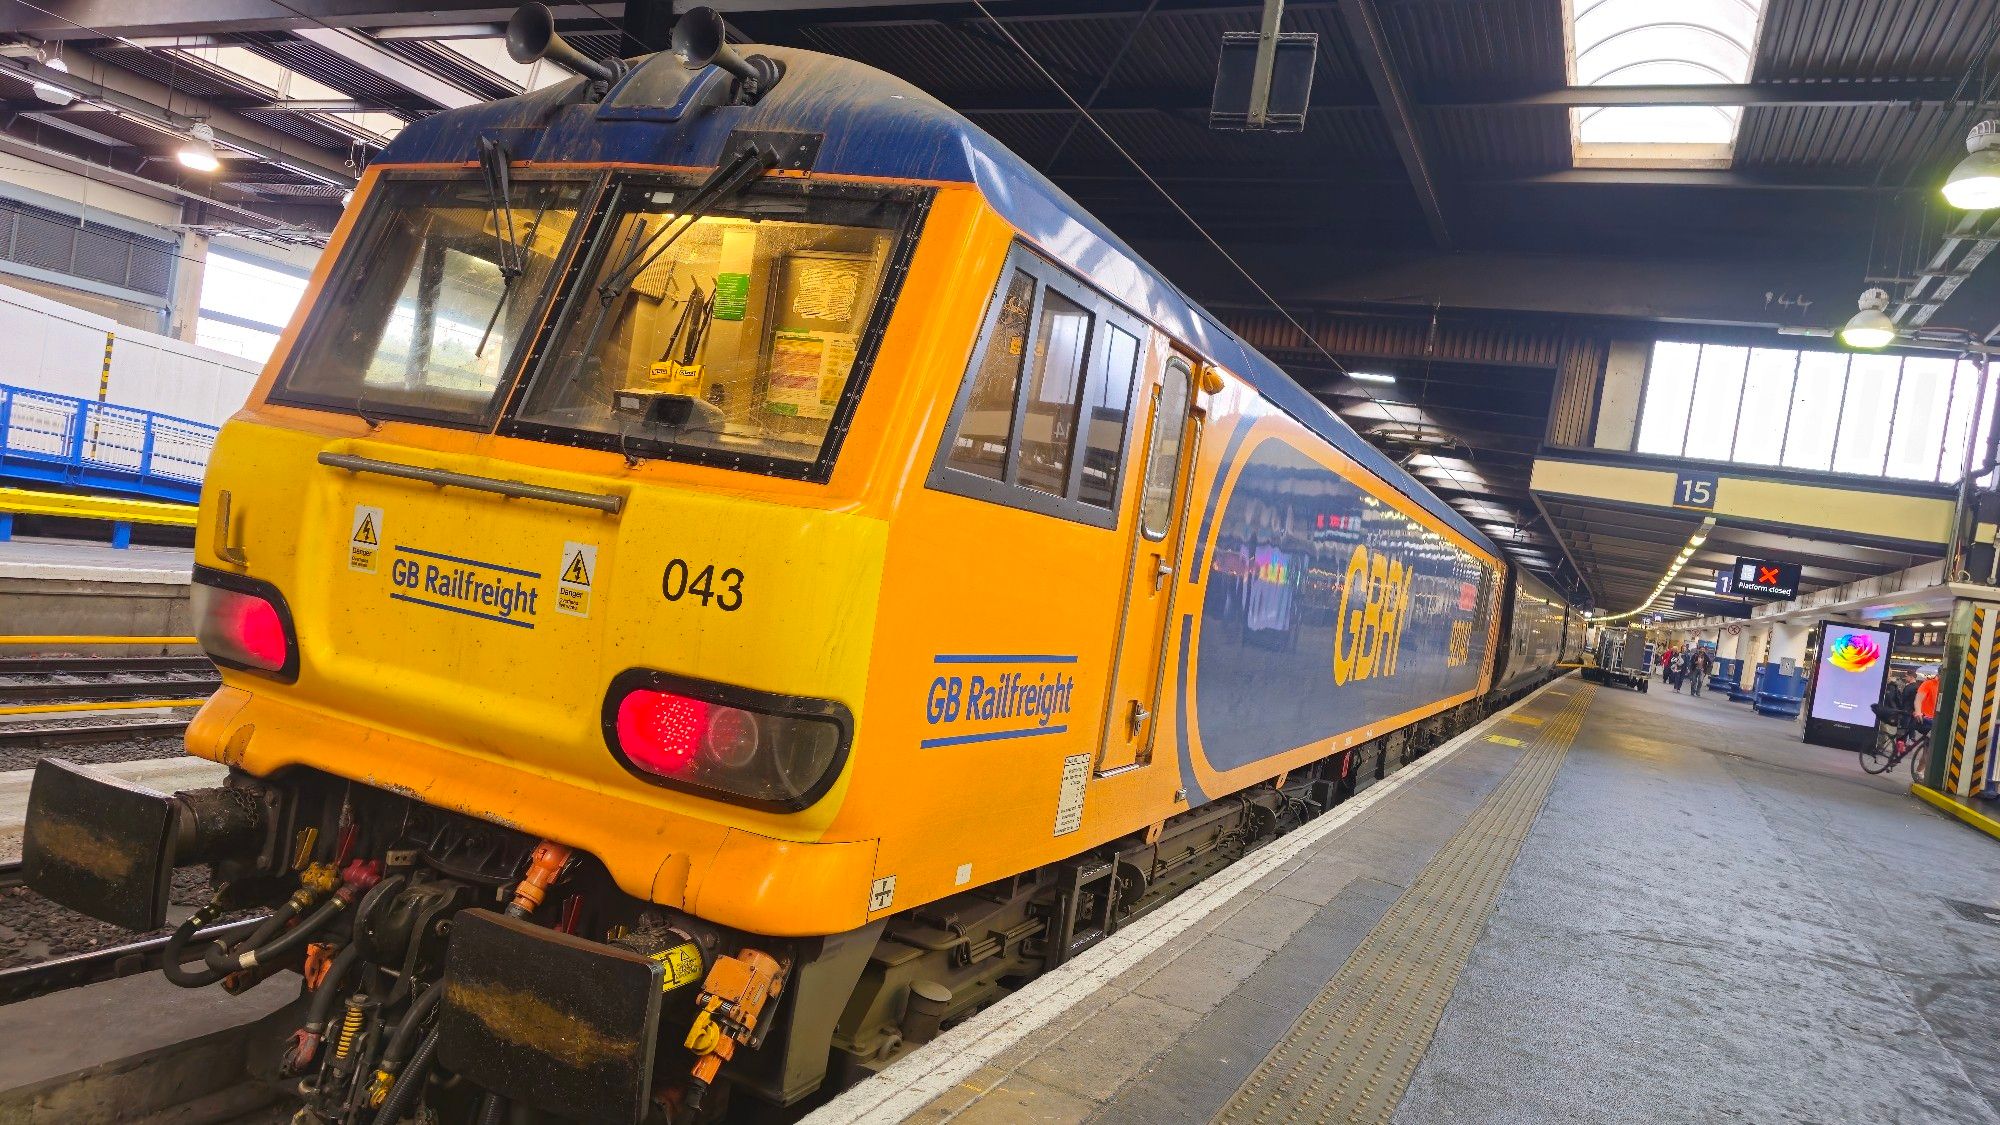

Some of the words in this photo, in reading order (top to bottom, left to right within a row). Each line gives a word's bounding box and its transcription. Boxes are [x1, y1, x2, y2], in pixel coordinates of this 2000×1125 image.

[1683, 480, 1711, 503] 15
[392, 558, 420, 589] GB
[424, 564, 538, 617] Railfreight
[559, 587, 584, 599] Danger
[662, 558, 744, 611] 043
[1721, 576, 1733, 593] 1
[1738, 581, 1768, 592] Platform
[1768, 586, 1792, 597] closed
[1333, 544, 1413, 687] GBRf
[926, 676, 963, 725] GB
[965, 672, 1074, 726] Railfreight
